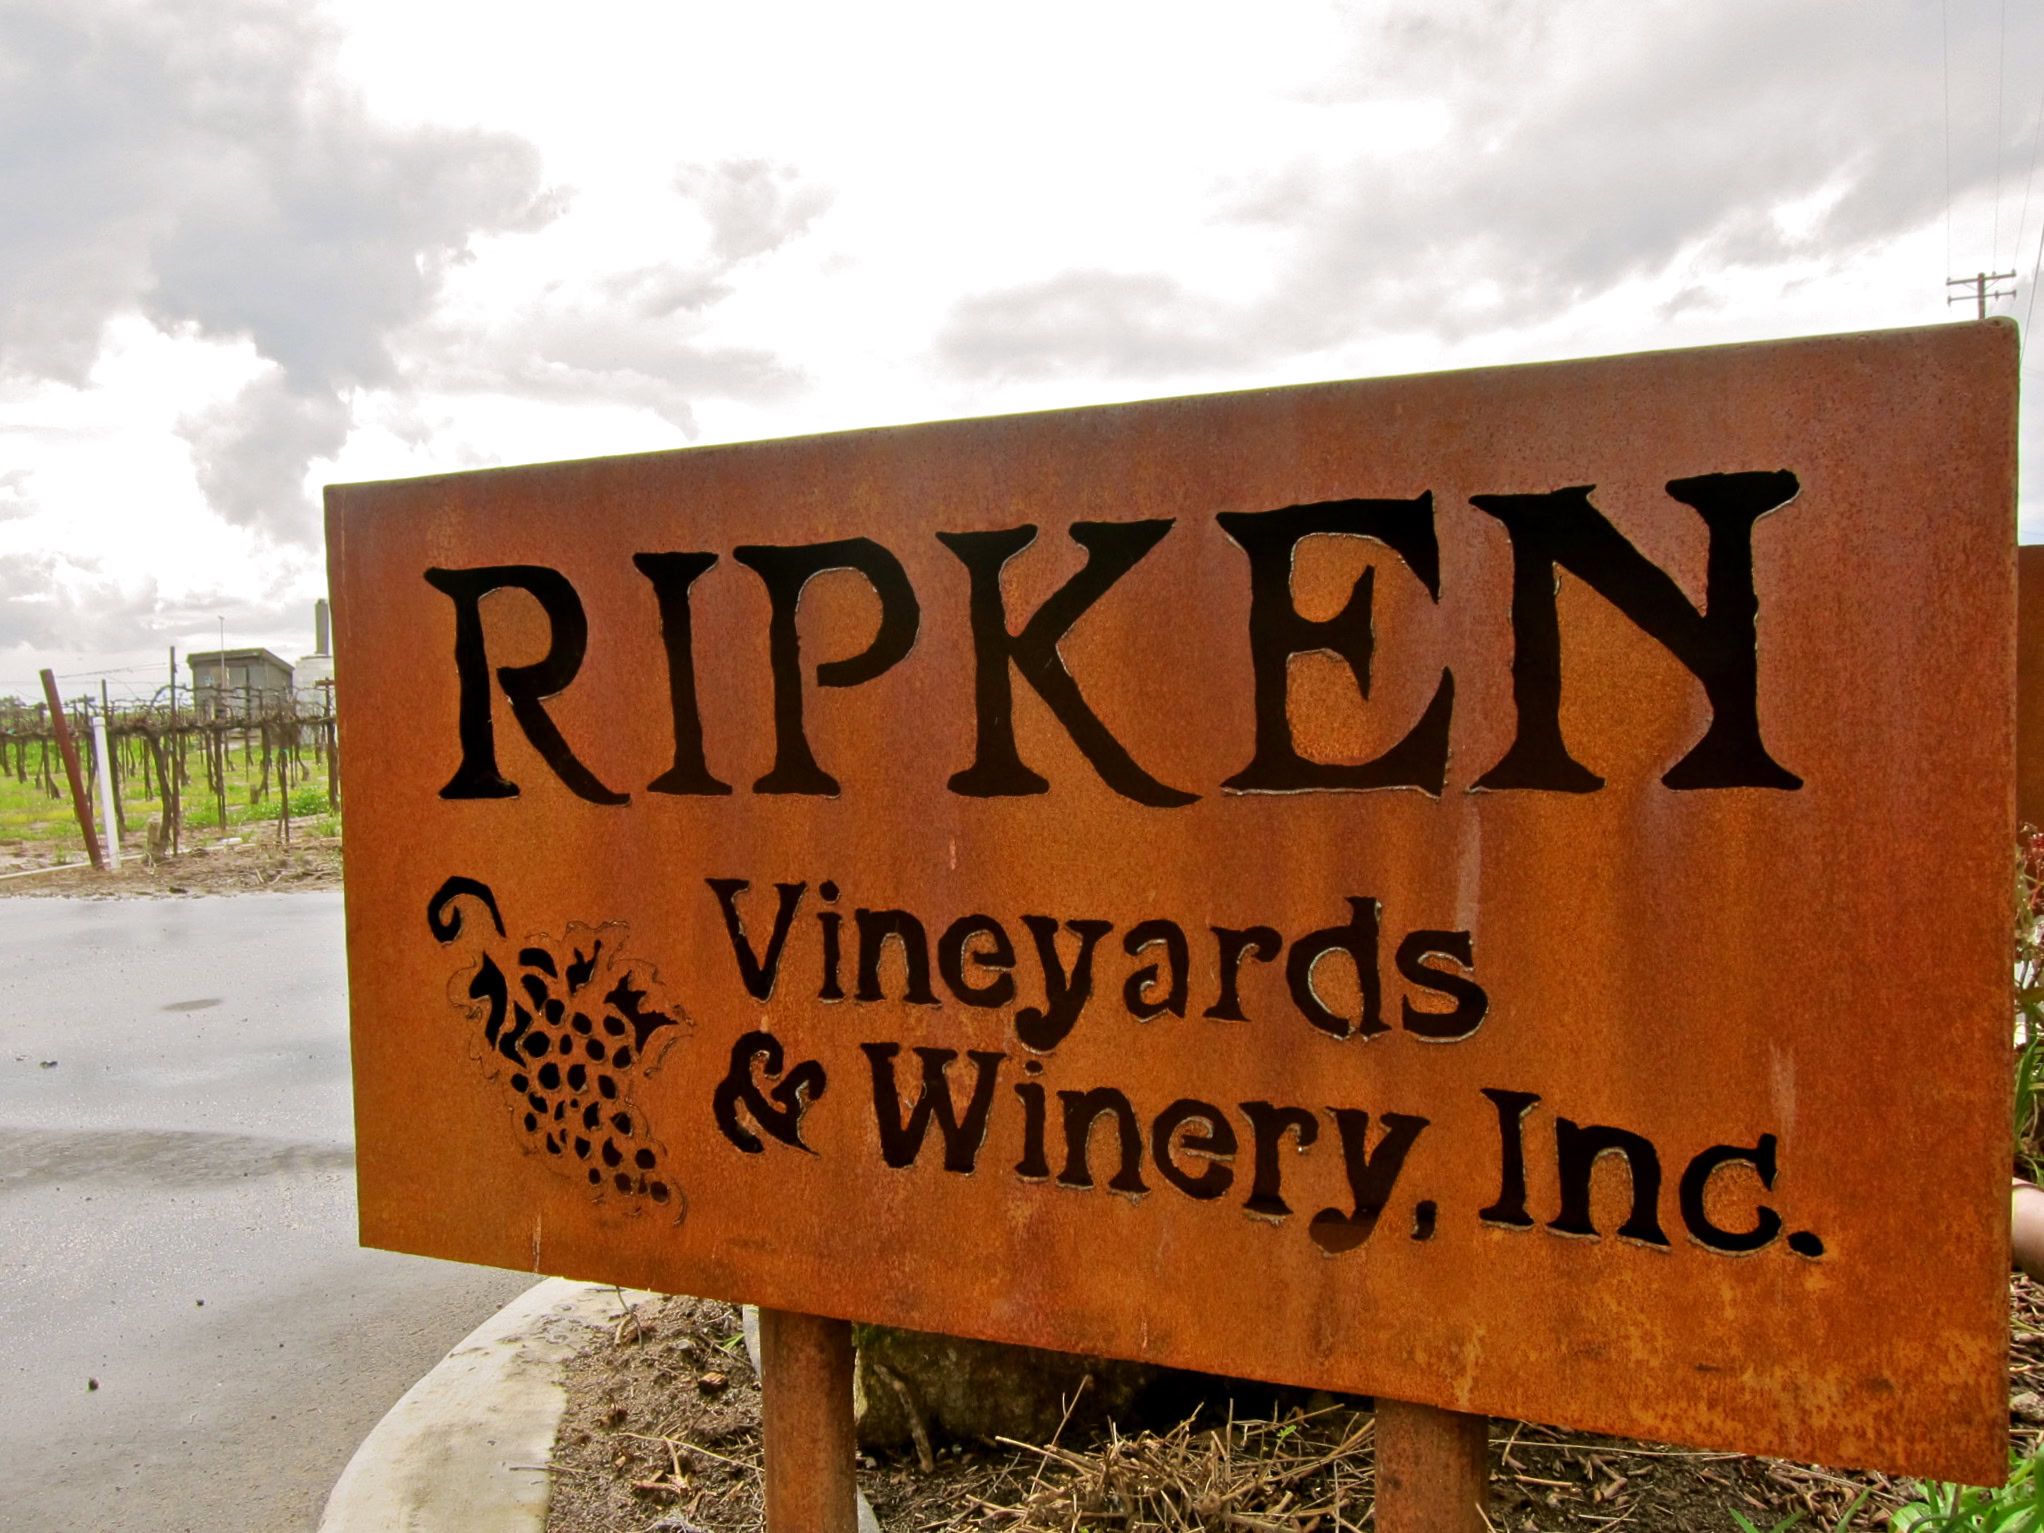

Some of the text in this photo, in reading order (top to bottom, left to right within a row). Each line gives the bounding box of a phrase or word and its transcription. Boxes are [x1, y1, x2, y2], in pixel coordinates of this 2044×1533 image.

[424, 470, 1804, 807] RIPKEN
[705, 877, 1487, 1056] Vineyards
[713, 1030, 1824, 1261] & Winery, Inc.
